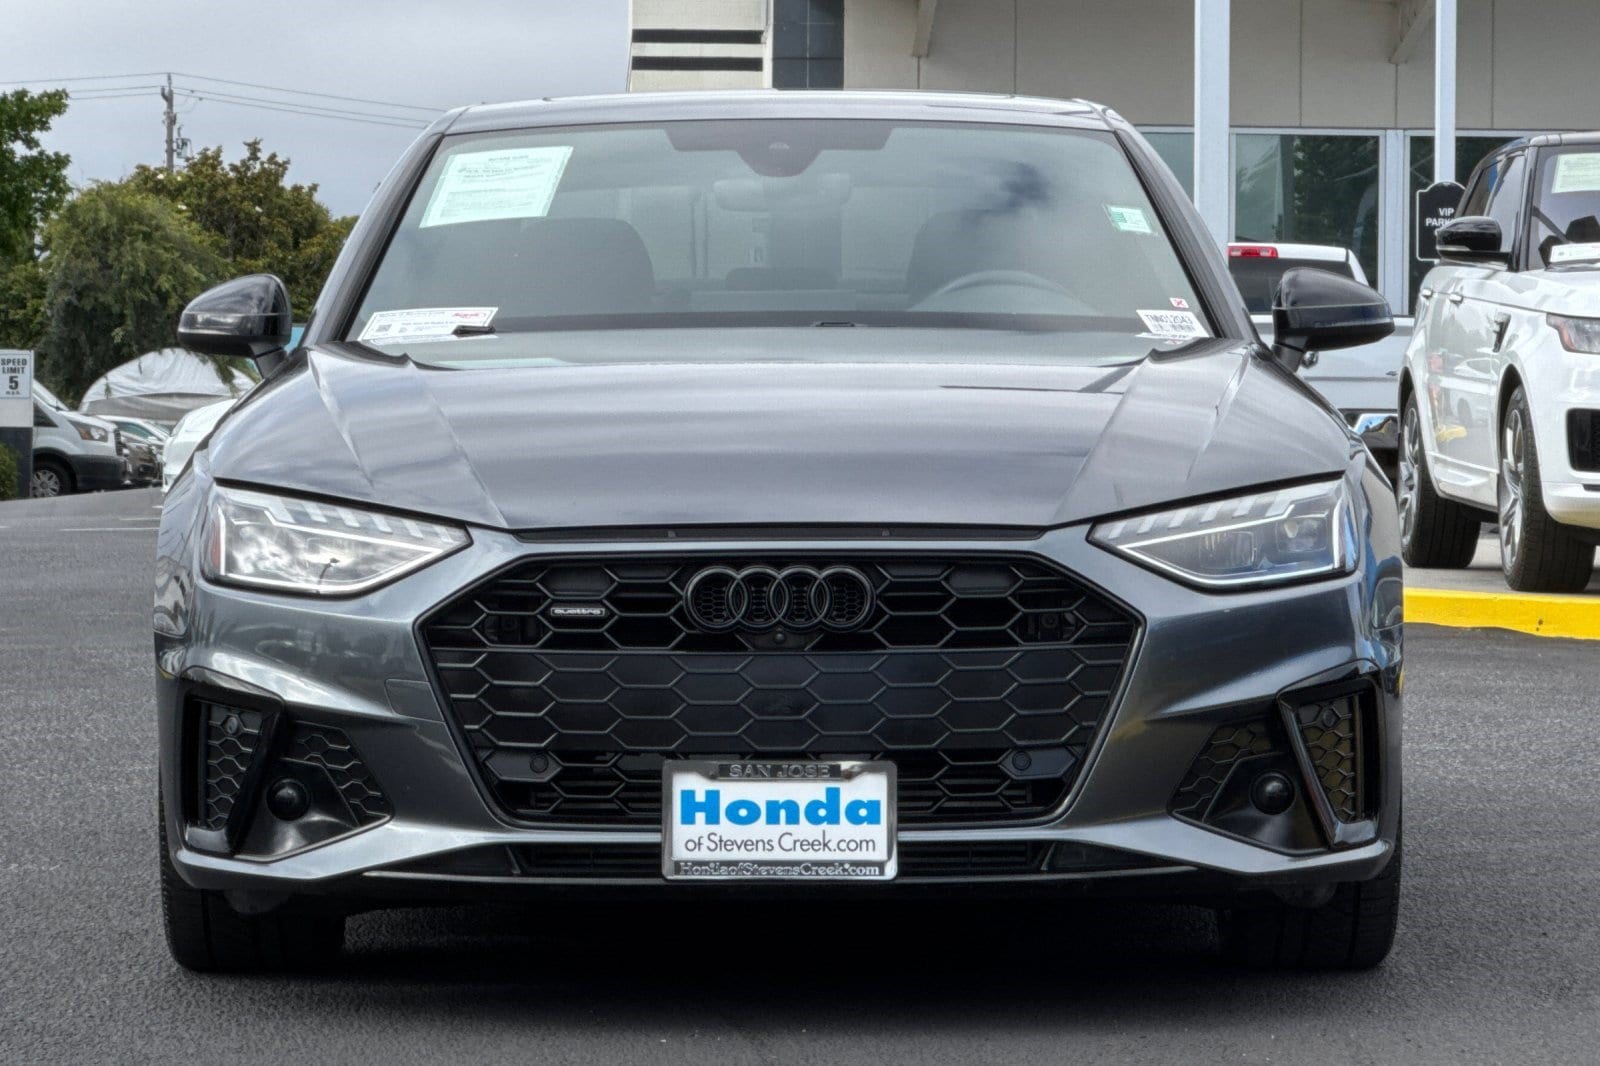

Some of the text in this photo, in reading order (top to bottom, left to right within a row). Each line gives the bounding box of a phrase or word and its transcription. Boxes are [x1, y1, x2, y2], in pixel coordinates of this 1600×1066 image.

[1438, 207, 1455, 217] VIP
[1, 358, 27, 366] SPEED
[2, 366, 25, 374] LIMIT
[9, 375, 19, 390] 5
[729, 764, 831, 777] SAN JOSE
[680, 787, 881, 825] Honda
[684, 830, 876, 852] of Stevens Creek.com
[680, 862, 880, 876] HondaofStevensCreek.com
